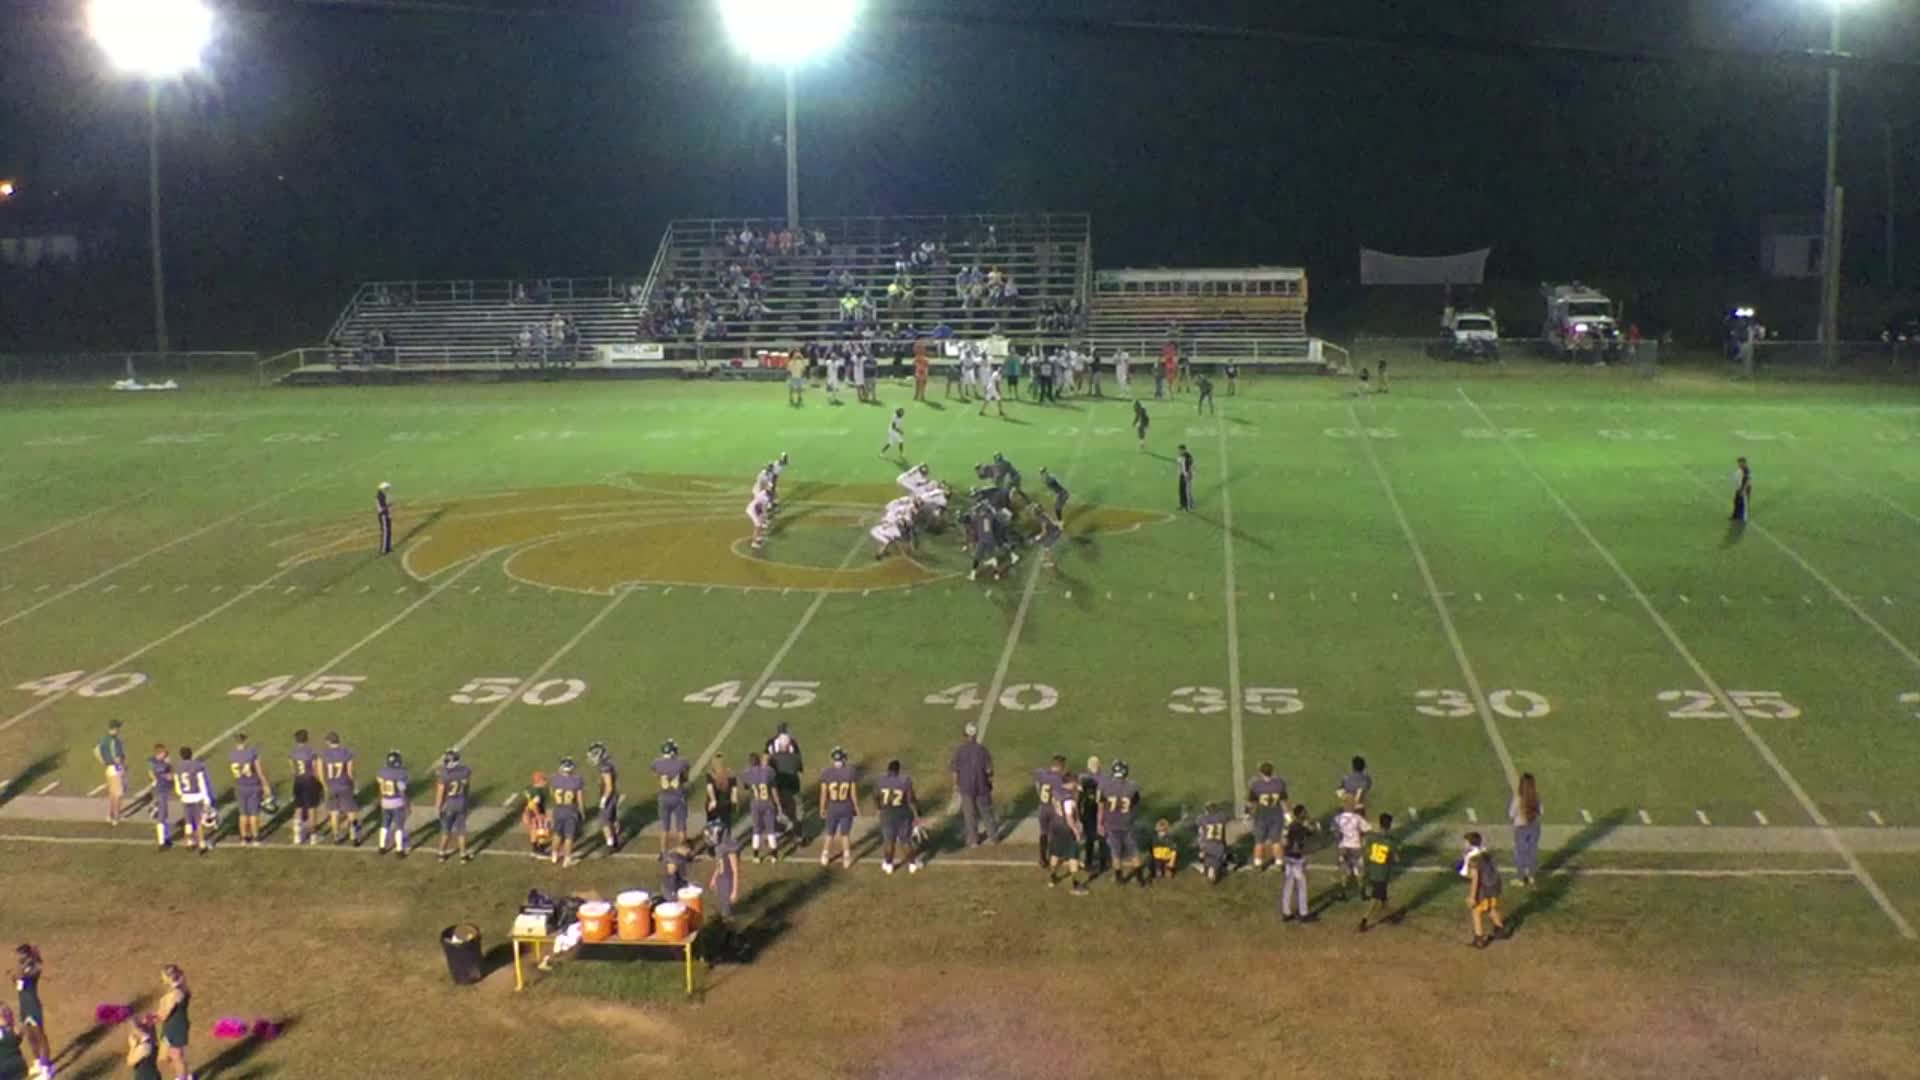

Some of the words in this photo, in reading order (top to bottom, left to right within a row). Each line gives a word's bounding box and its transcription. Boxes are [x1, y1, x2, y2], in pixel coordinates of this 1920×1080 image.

[15, 671, 147, 697] 40
[227, 675, 367, 701] 45
[450, 677, 587, 706] 50
[683, 680, 821, 708] 45
[924, 683, 1059, 712] 40
[1168, 686, 1304, 714] 35
[1415, 689, 1551, 718] 30
[1655, 689, 1801, 719] 25
